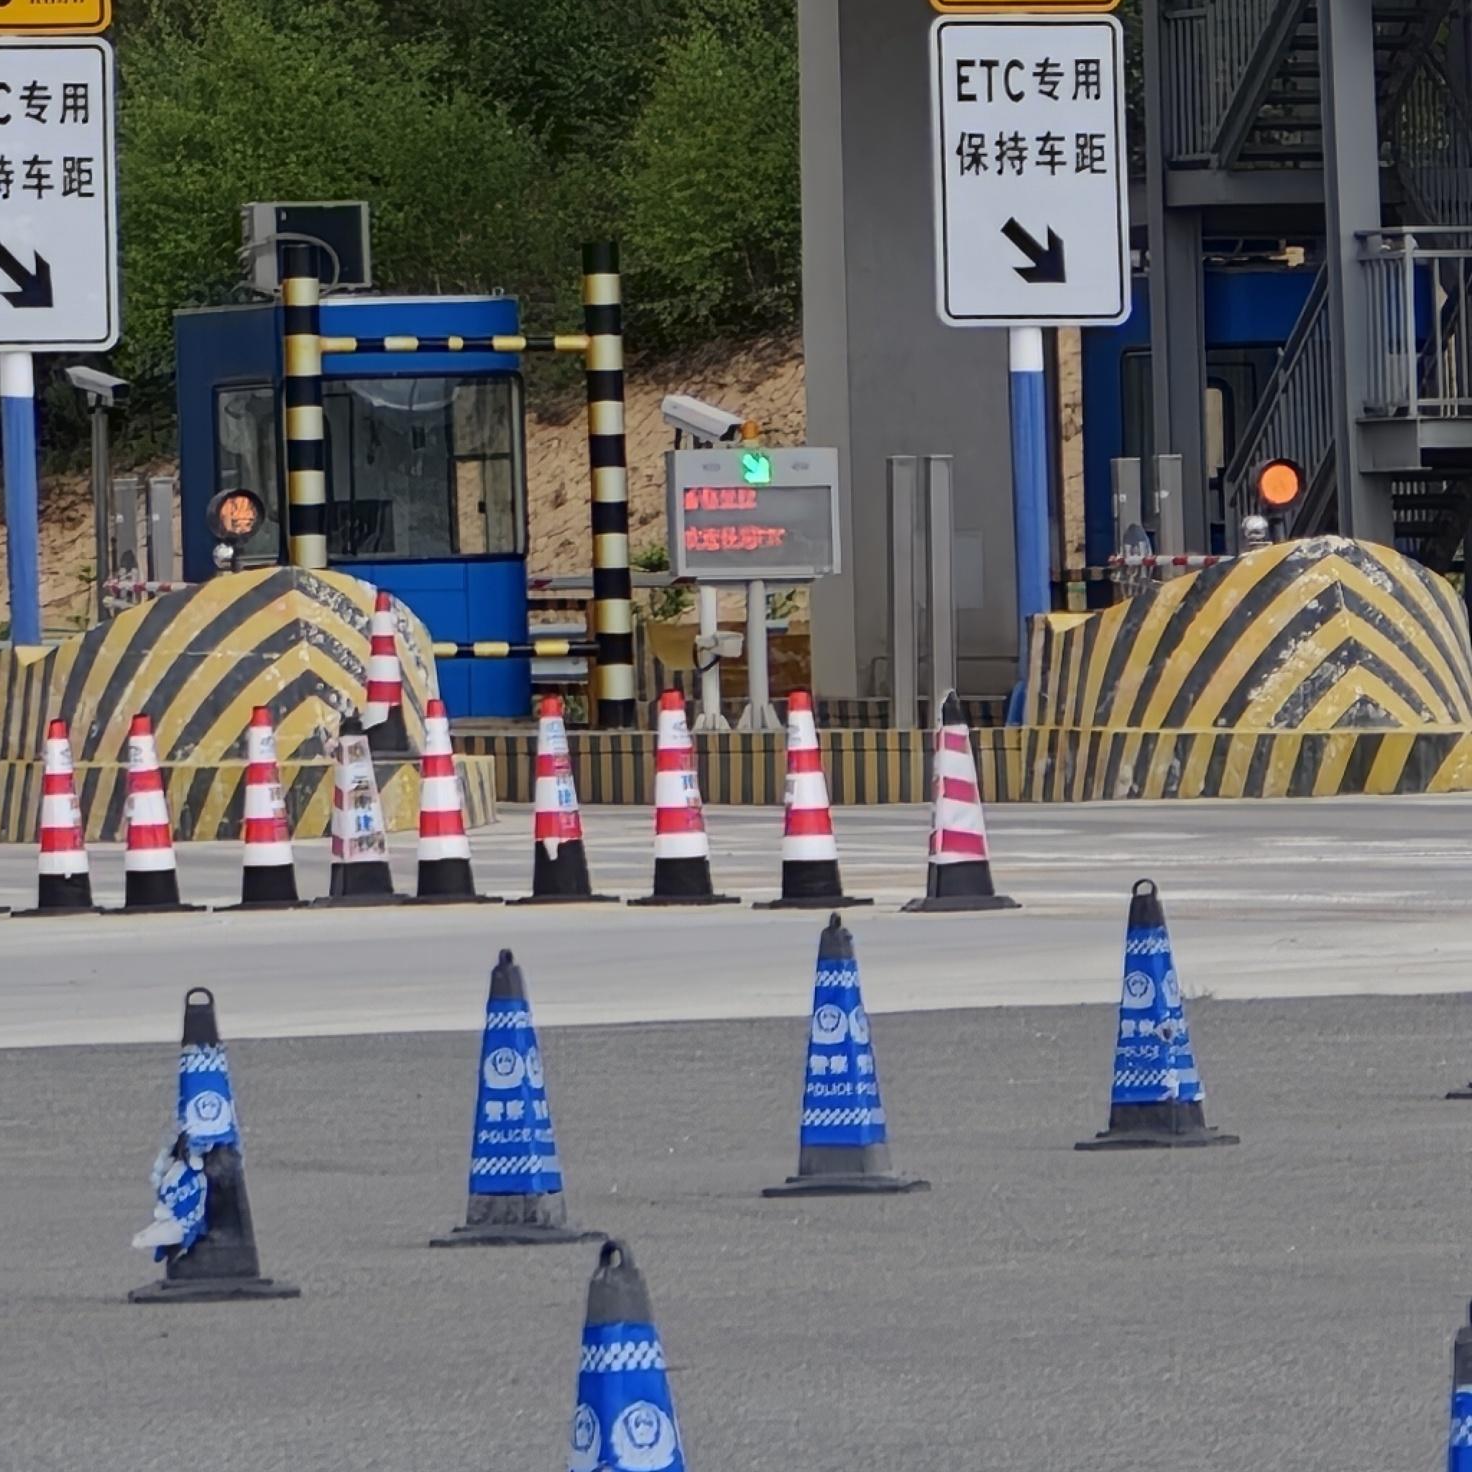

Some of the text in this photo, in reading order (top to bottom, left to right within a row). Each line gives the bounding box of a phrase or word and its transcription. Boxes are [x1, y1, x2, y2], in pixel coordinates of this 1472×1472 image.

[955, 57, 1102, 103] ETC专用
[955, 131, 1108, 176] 保持车距
